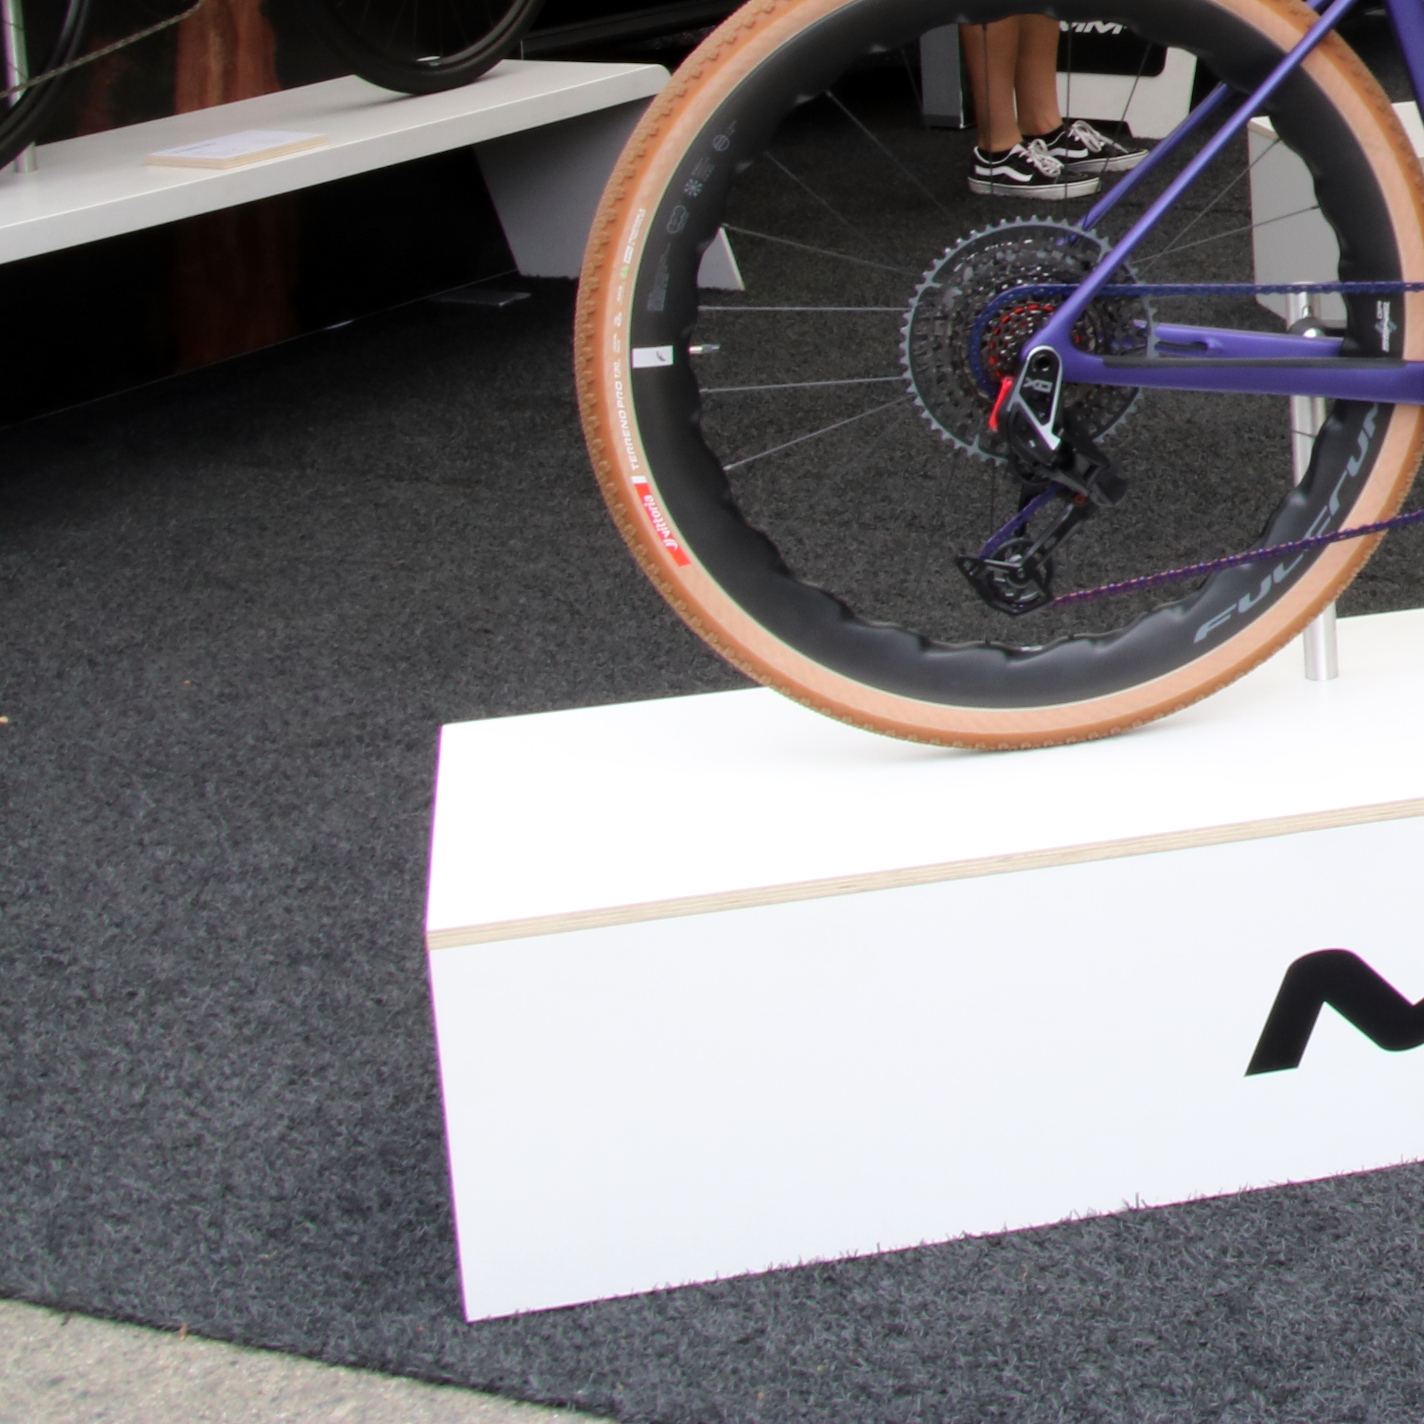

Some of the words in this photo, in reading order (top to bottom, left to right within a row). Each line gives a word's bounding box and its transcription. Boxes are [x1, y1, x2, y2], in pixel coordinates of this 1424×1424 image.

[613, 380, 626, 409] PRO
[616, 411, 640, 471] TERRENO
[643, 494, 672, 539] vittoria
